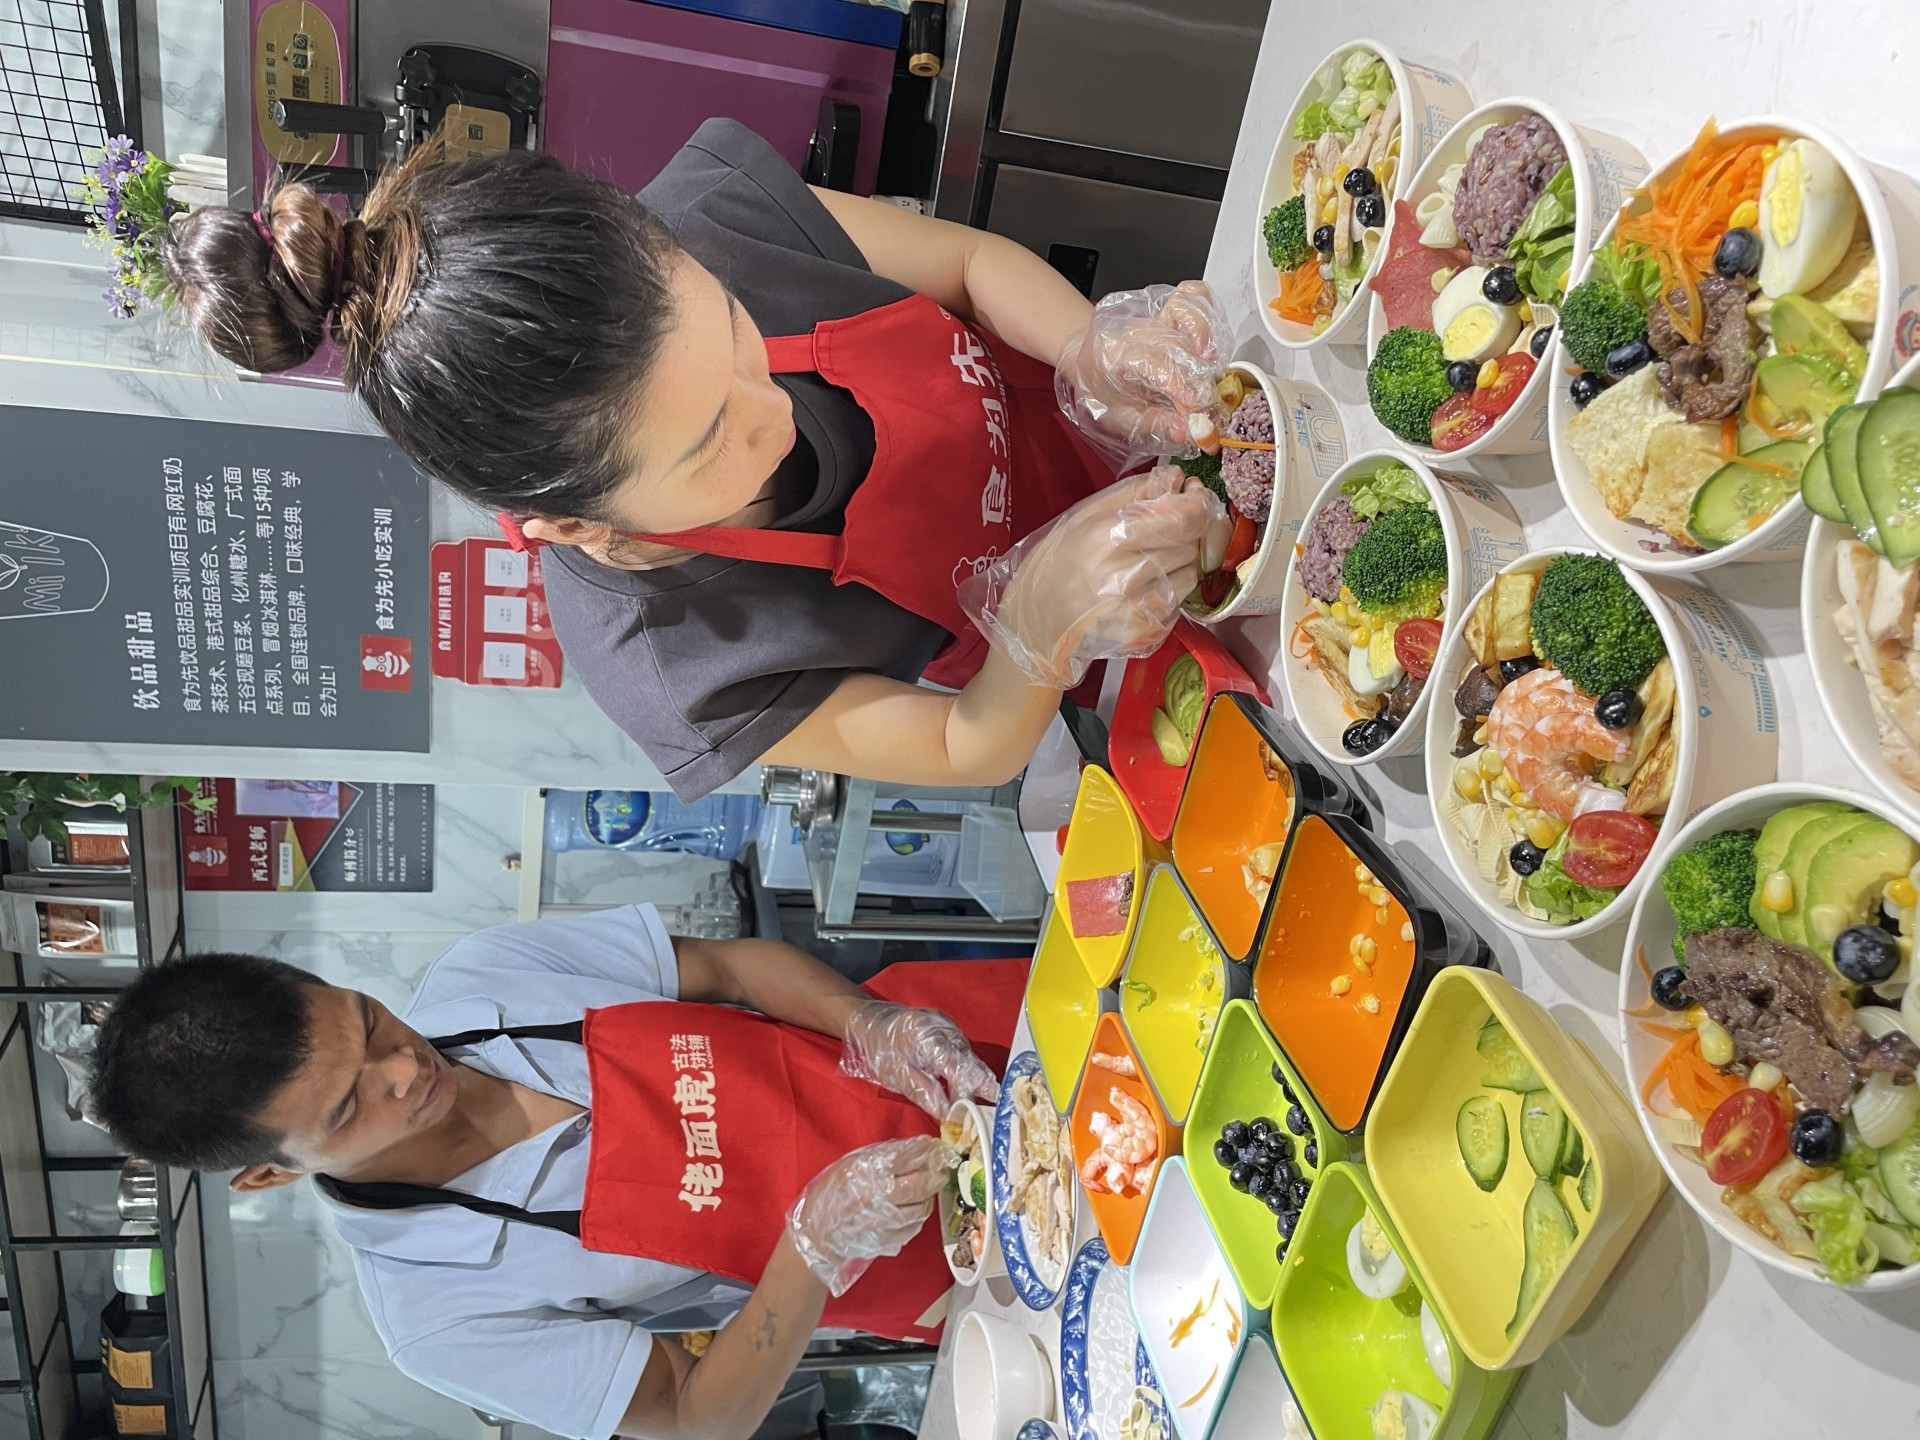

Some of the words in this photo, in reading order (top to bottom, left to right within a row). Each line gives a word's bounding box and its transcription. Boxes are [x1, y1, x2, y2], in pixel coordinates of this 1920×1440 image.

[950, 330, 1007, 527] 食为先
[224, 466, 257, 714] 五谷现磨豆浆、化州糖水、广式面
[373, 508, 394, 631] 食为先小吃实训
[125, 610, 161, 710] 饮品甜品
[248, 826, 268, 882] 西式老师
[669, 1034, 689, 1072] 古法
[687, 1034, 707, 1070] 饼铺
[672, 1071, 724, 1212] 佬面虎
